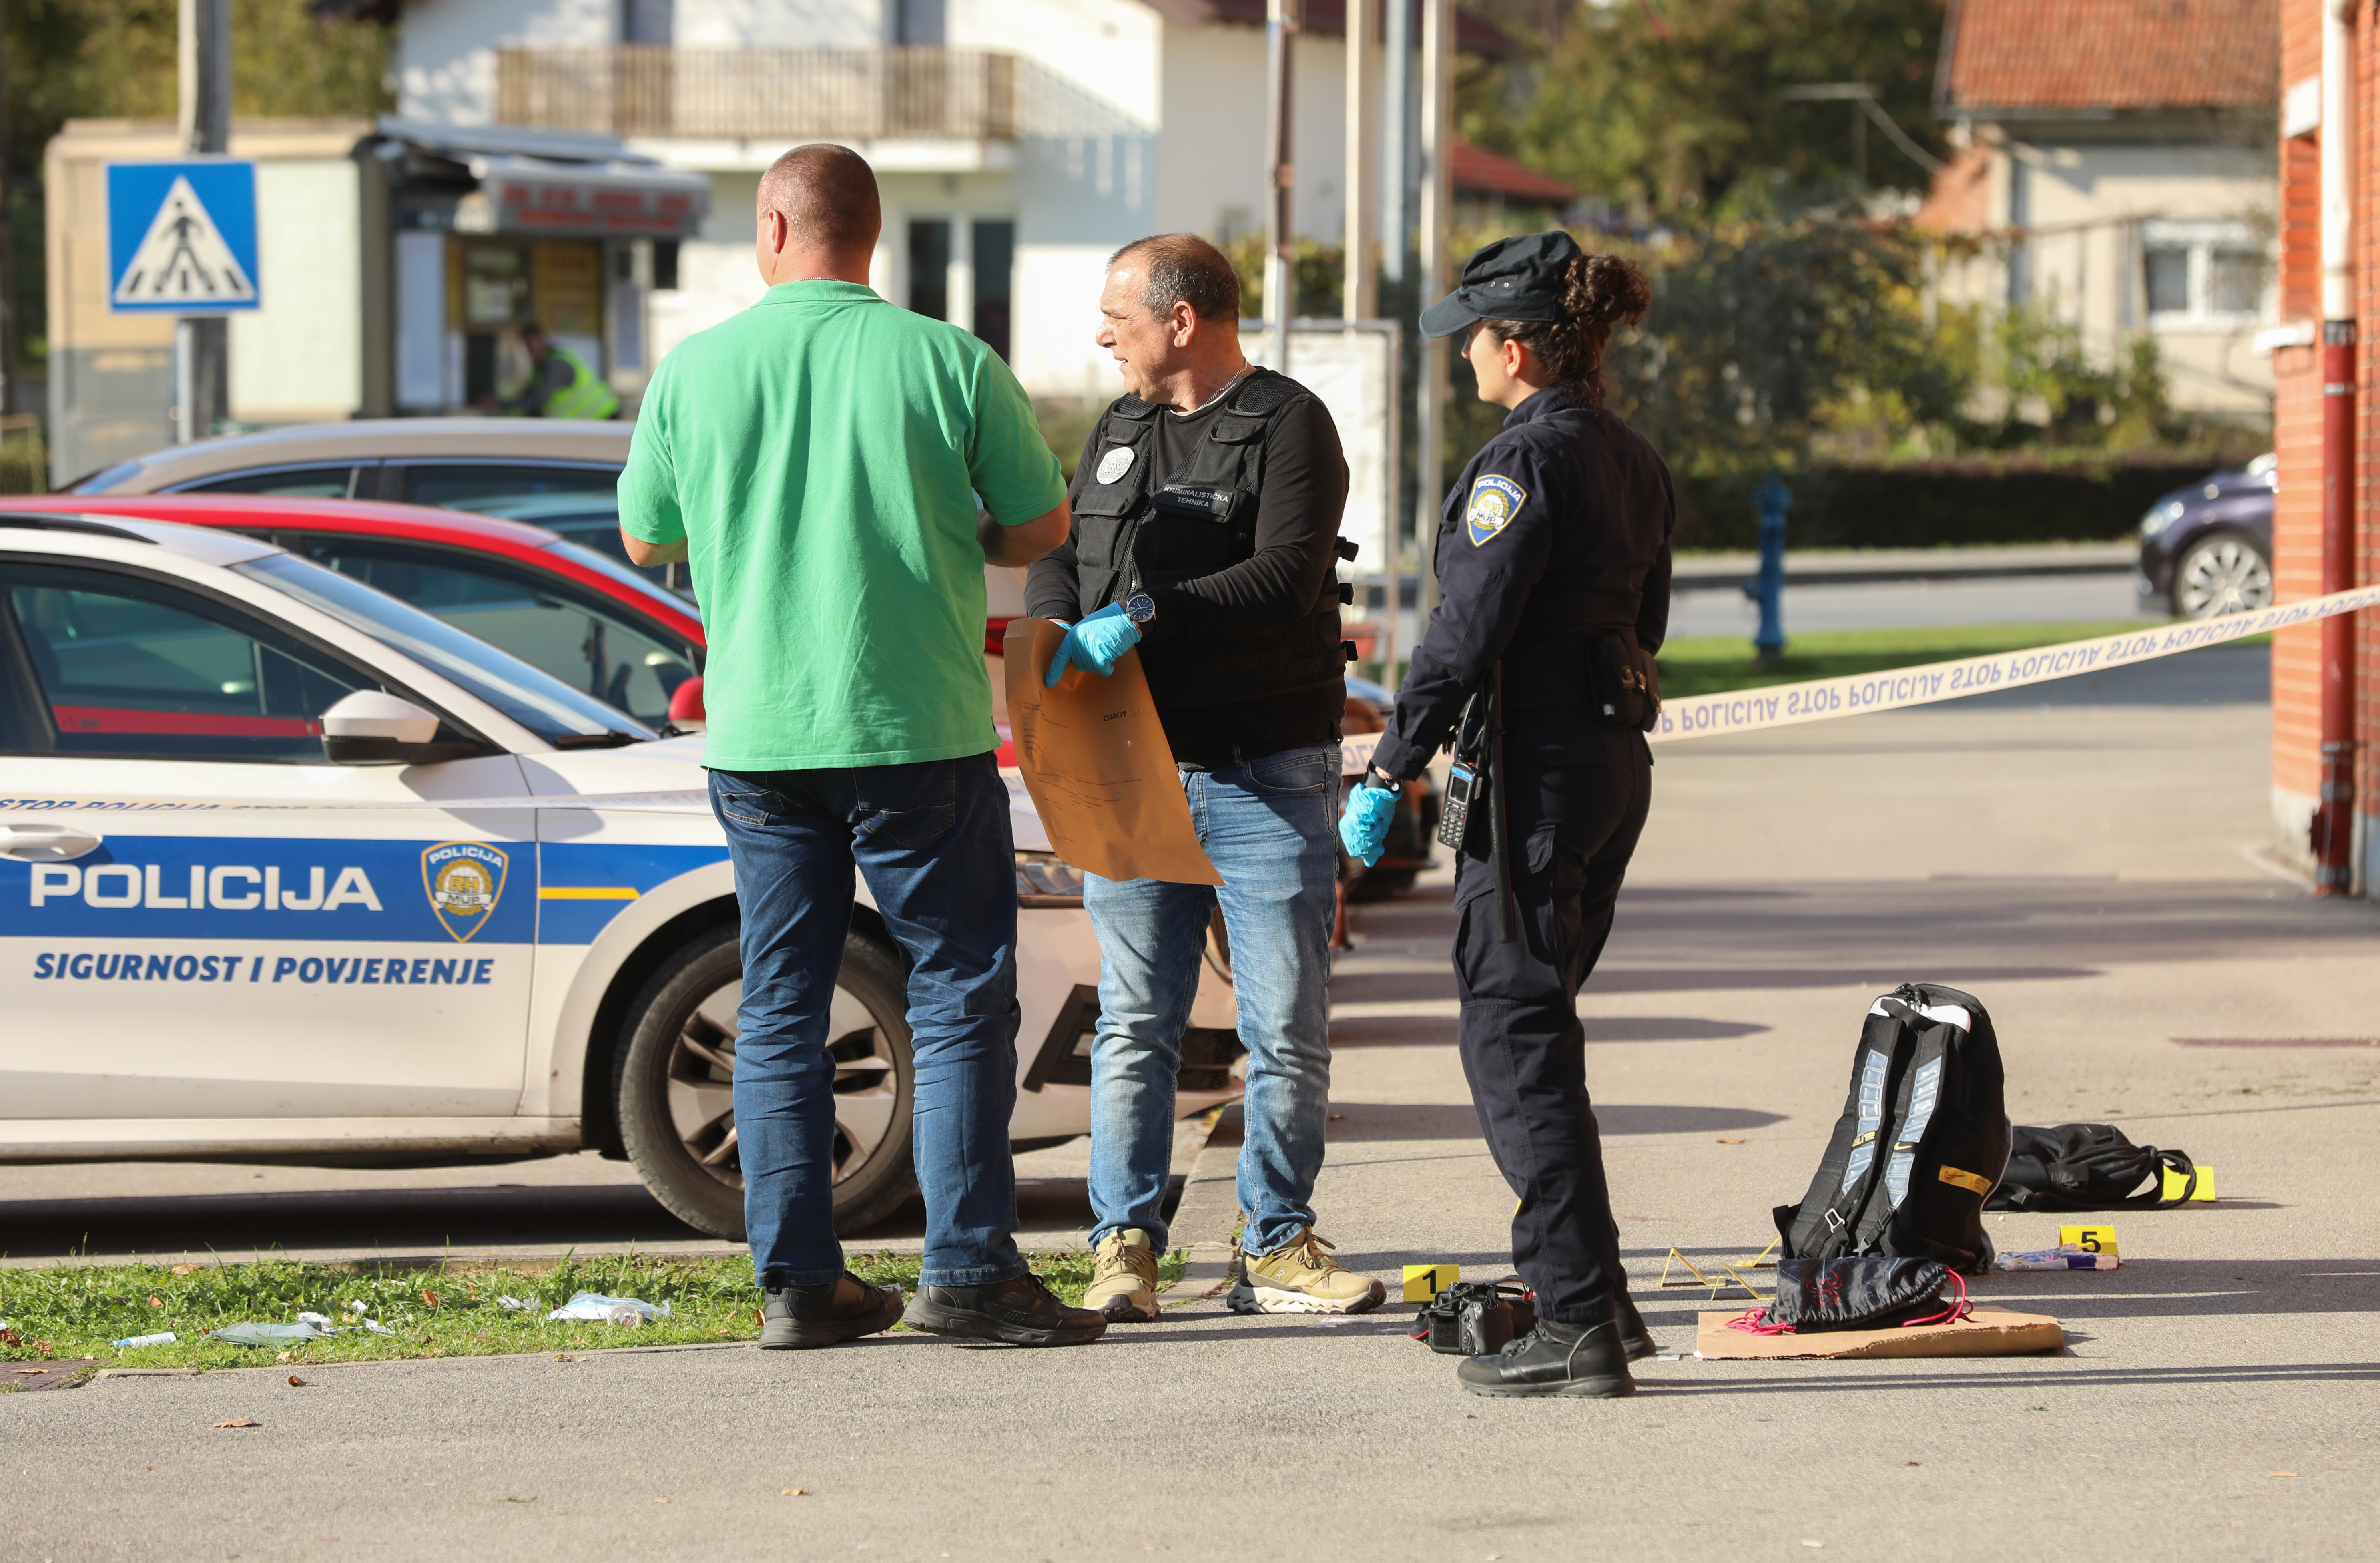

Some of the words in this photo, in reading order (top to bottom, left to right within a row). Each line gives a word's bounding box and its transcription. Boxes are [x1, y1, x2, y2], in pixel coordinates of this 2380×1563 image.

[1164, 486, 1228, 502] KRIMINALISTIČKA
[1477, 479, 1521, 502] POLICIJA
[1178, 497, 1209, 507] TEHNIKA
[1482, 499, 1500, 514] RH
[1477, 512, 1496, 522] MUP
[1103, 711, 1128, 721] OMOT
[0, 799, 77, 810] STOP
[428, 846, 502, 868] POLICIJA
[30, 864, 383, 911] POLICIJA
[449, 876, 479, 893] RH
[448, 895, 480, 904] MUP
[34, 953, 243, 982] SIGURNOST
[250, 956, 264, 982] I
[272, 957, 494, 985] POVJERENJE
[2081, 1231, 2101, 1253] 5
[1422, 1270, 1437, 1294] 1
